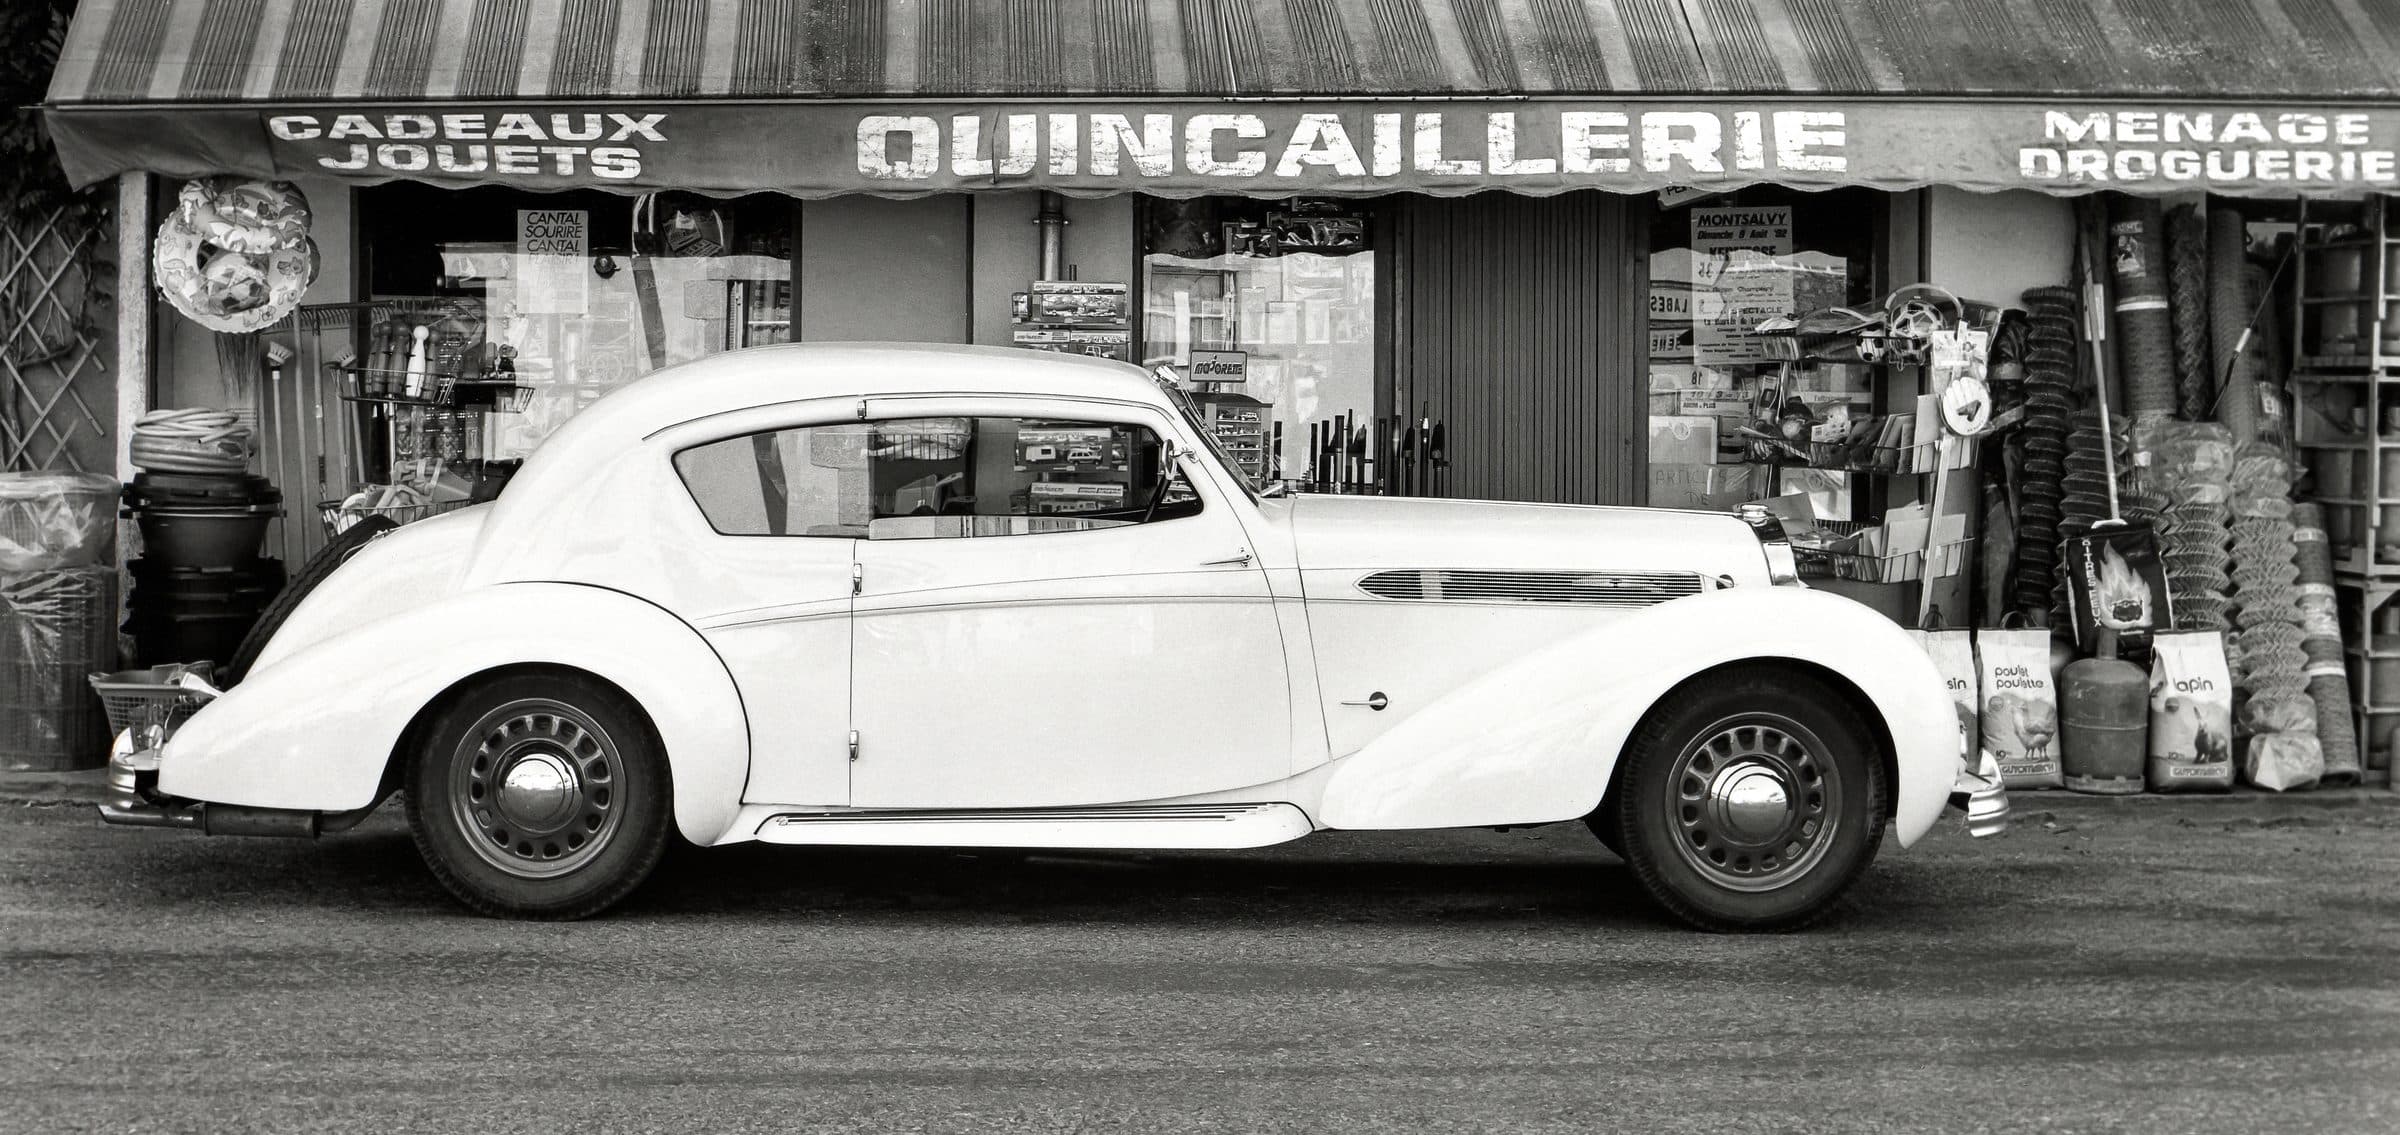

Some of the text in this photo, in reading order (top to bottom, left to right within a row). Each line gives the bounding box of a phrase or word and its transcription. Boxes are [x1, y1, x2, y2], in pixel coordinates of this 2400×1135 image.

[269, 113, 668, 141] CADEAUX
[2045, 110, 2369, 144] MENAGE
[856, 111, 1847, 179] QUINCAILLERIE
[317, 144, 641, 179] JOUETS
[2019, 148, 2395, 181] DROGUERIE
[527, 212, 581, 225] CANTAL
[1697, 212, 1787, 227] MONTSALVY
[525, 225, 583, 238] SOURIRE
[527, 239, 581, 252] CANTAL
[1995, 664, 2029, 678] poulet
[1996, 677, 2044, 690] poulette
[2173, 677, 2213, 693] lapin
